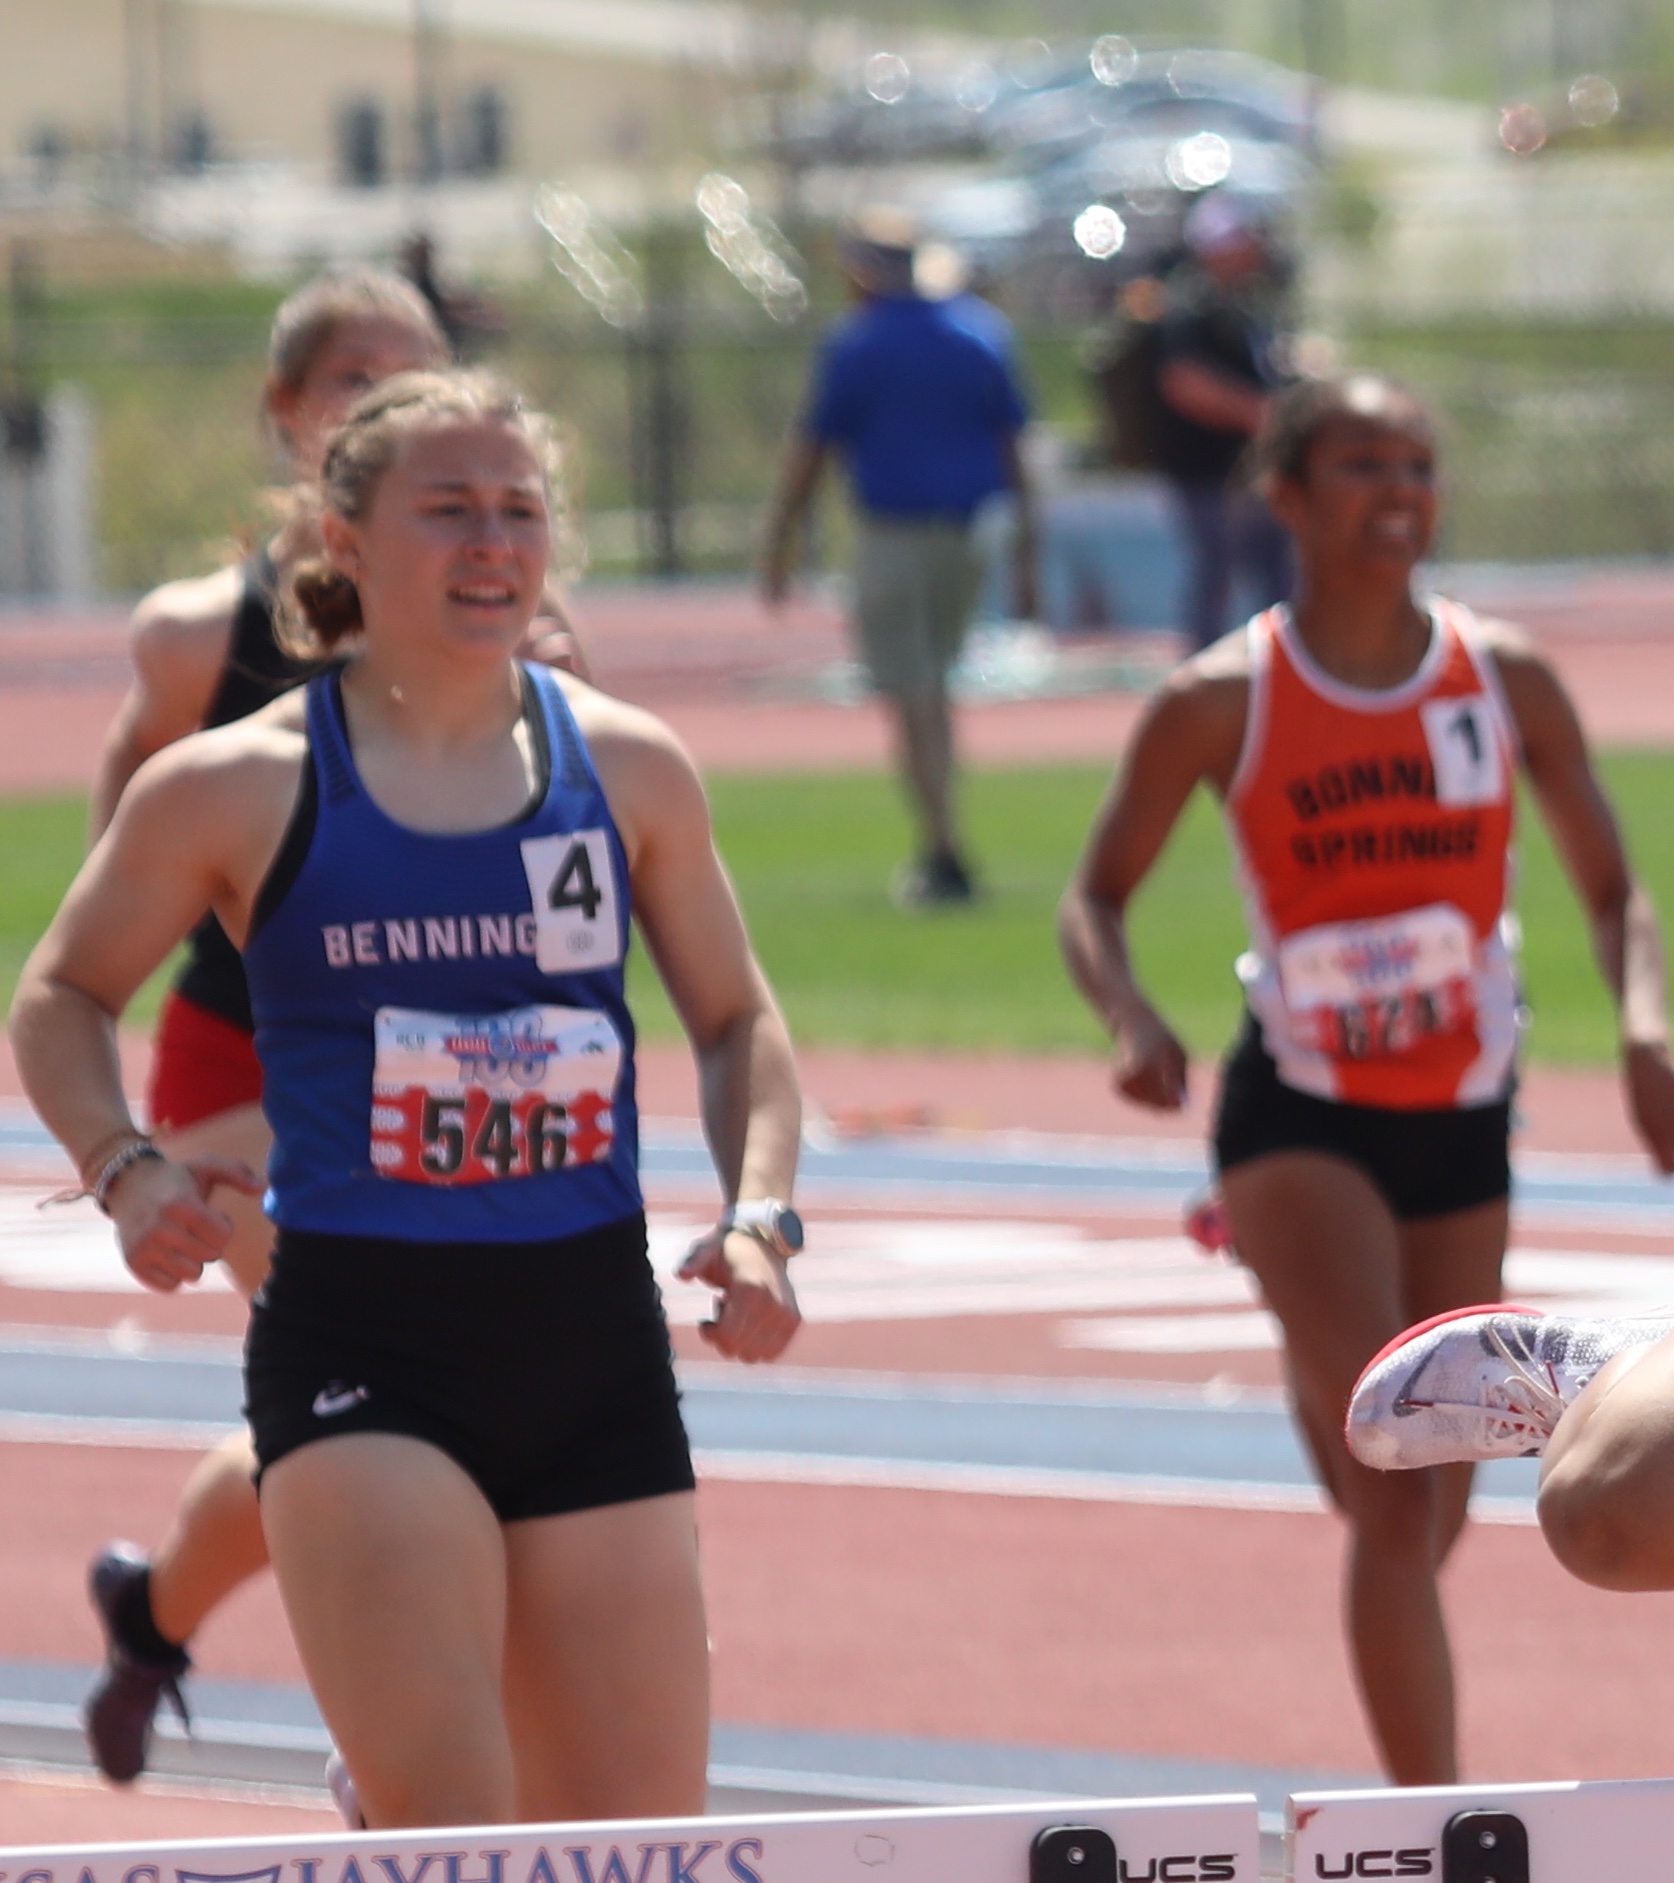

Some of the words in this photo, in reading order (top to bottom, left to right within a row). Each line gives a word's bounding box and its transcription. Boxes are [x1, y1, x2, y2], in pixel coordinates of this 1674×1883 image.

[1446, 706, 1483, 768] 1
[1289, 755, 1437, 818] BONN
[548, 840, 602, 920] 4
[420, 1096, 569, 1176] 546
[1118, 1854, 1236, 1883] UCS
[1315, 1849, 1433, 1880] UCS
